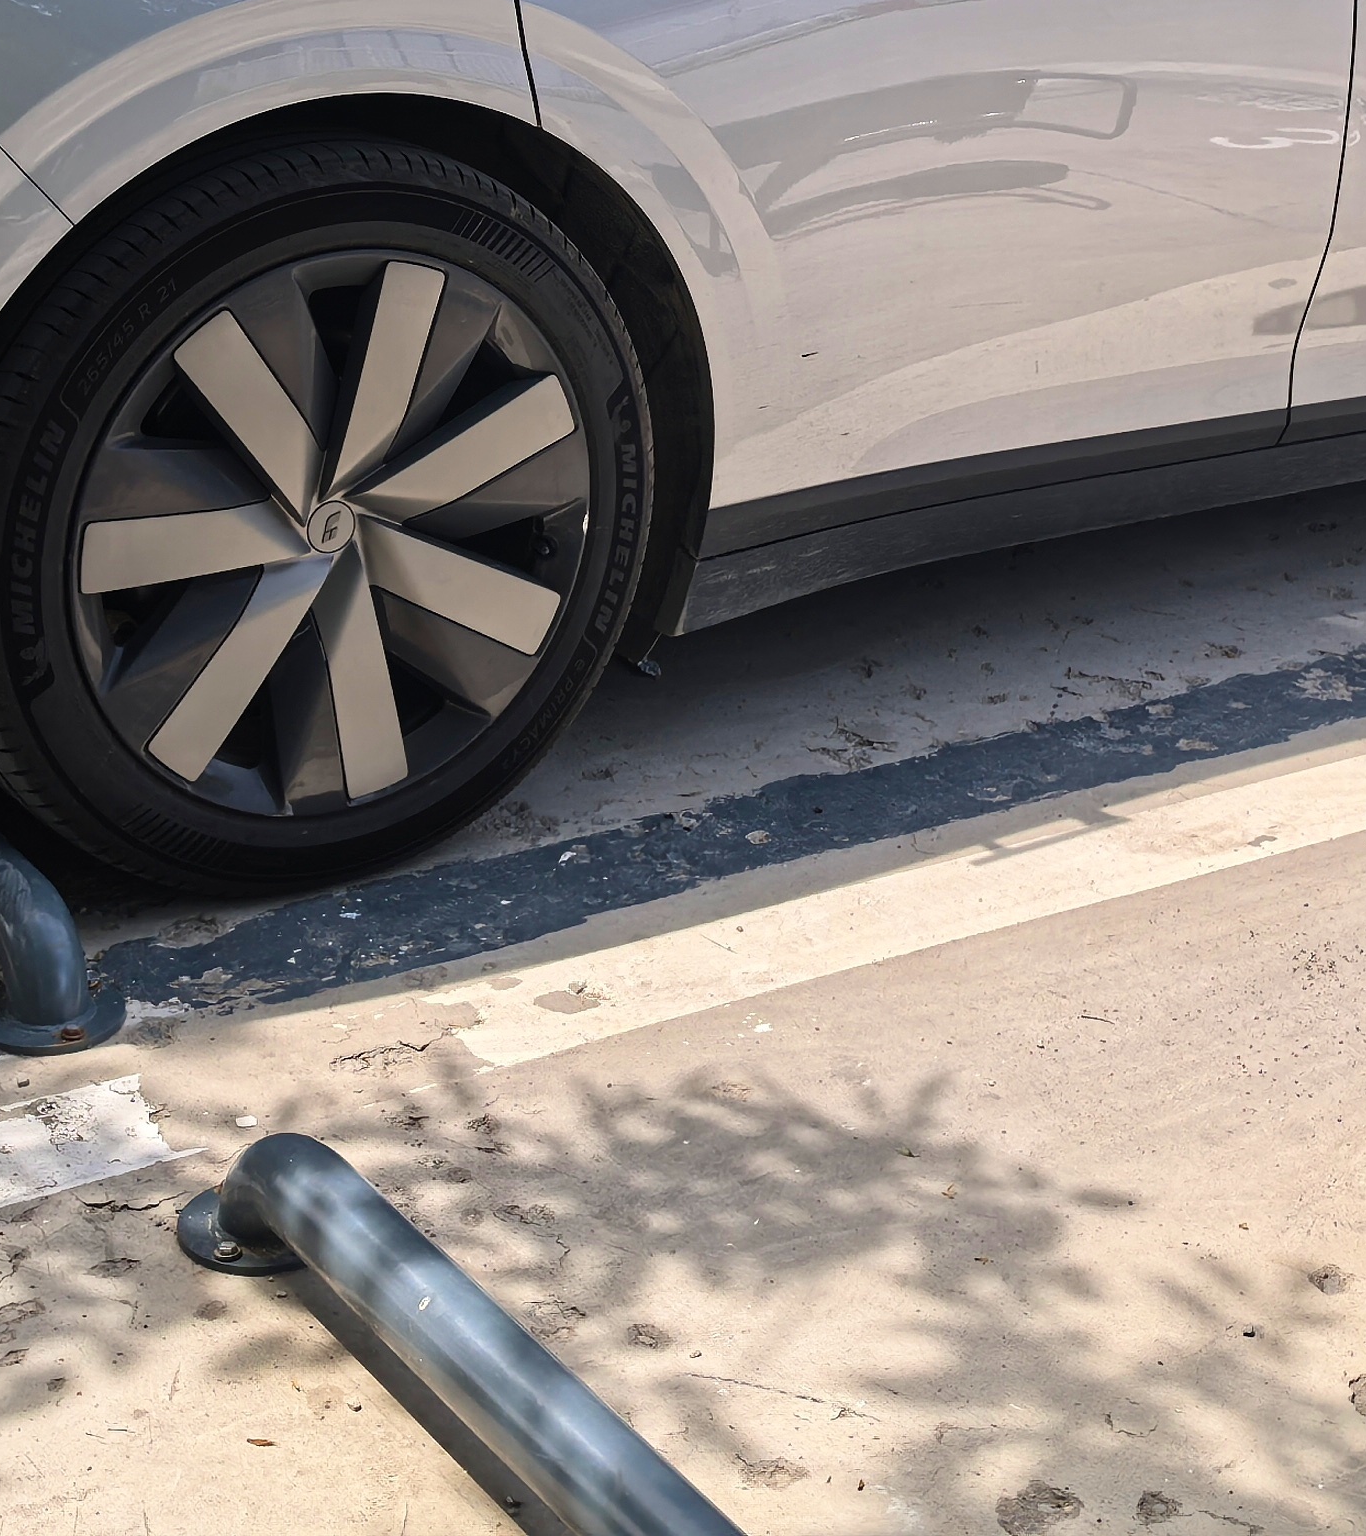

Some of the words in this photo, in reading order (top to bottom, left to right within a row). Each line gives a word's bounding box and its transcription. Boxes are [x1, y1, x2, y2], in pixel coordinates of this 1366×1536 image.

[77, 318, 136, 396] 265/45
[137, 302, 152, 321] R
[156, 277, 178, 303] 21
[9, 417, 69, 636] MICHELIN
[592, 441, 638, 636] MICHELIN
